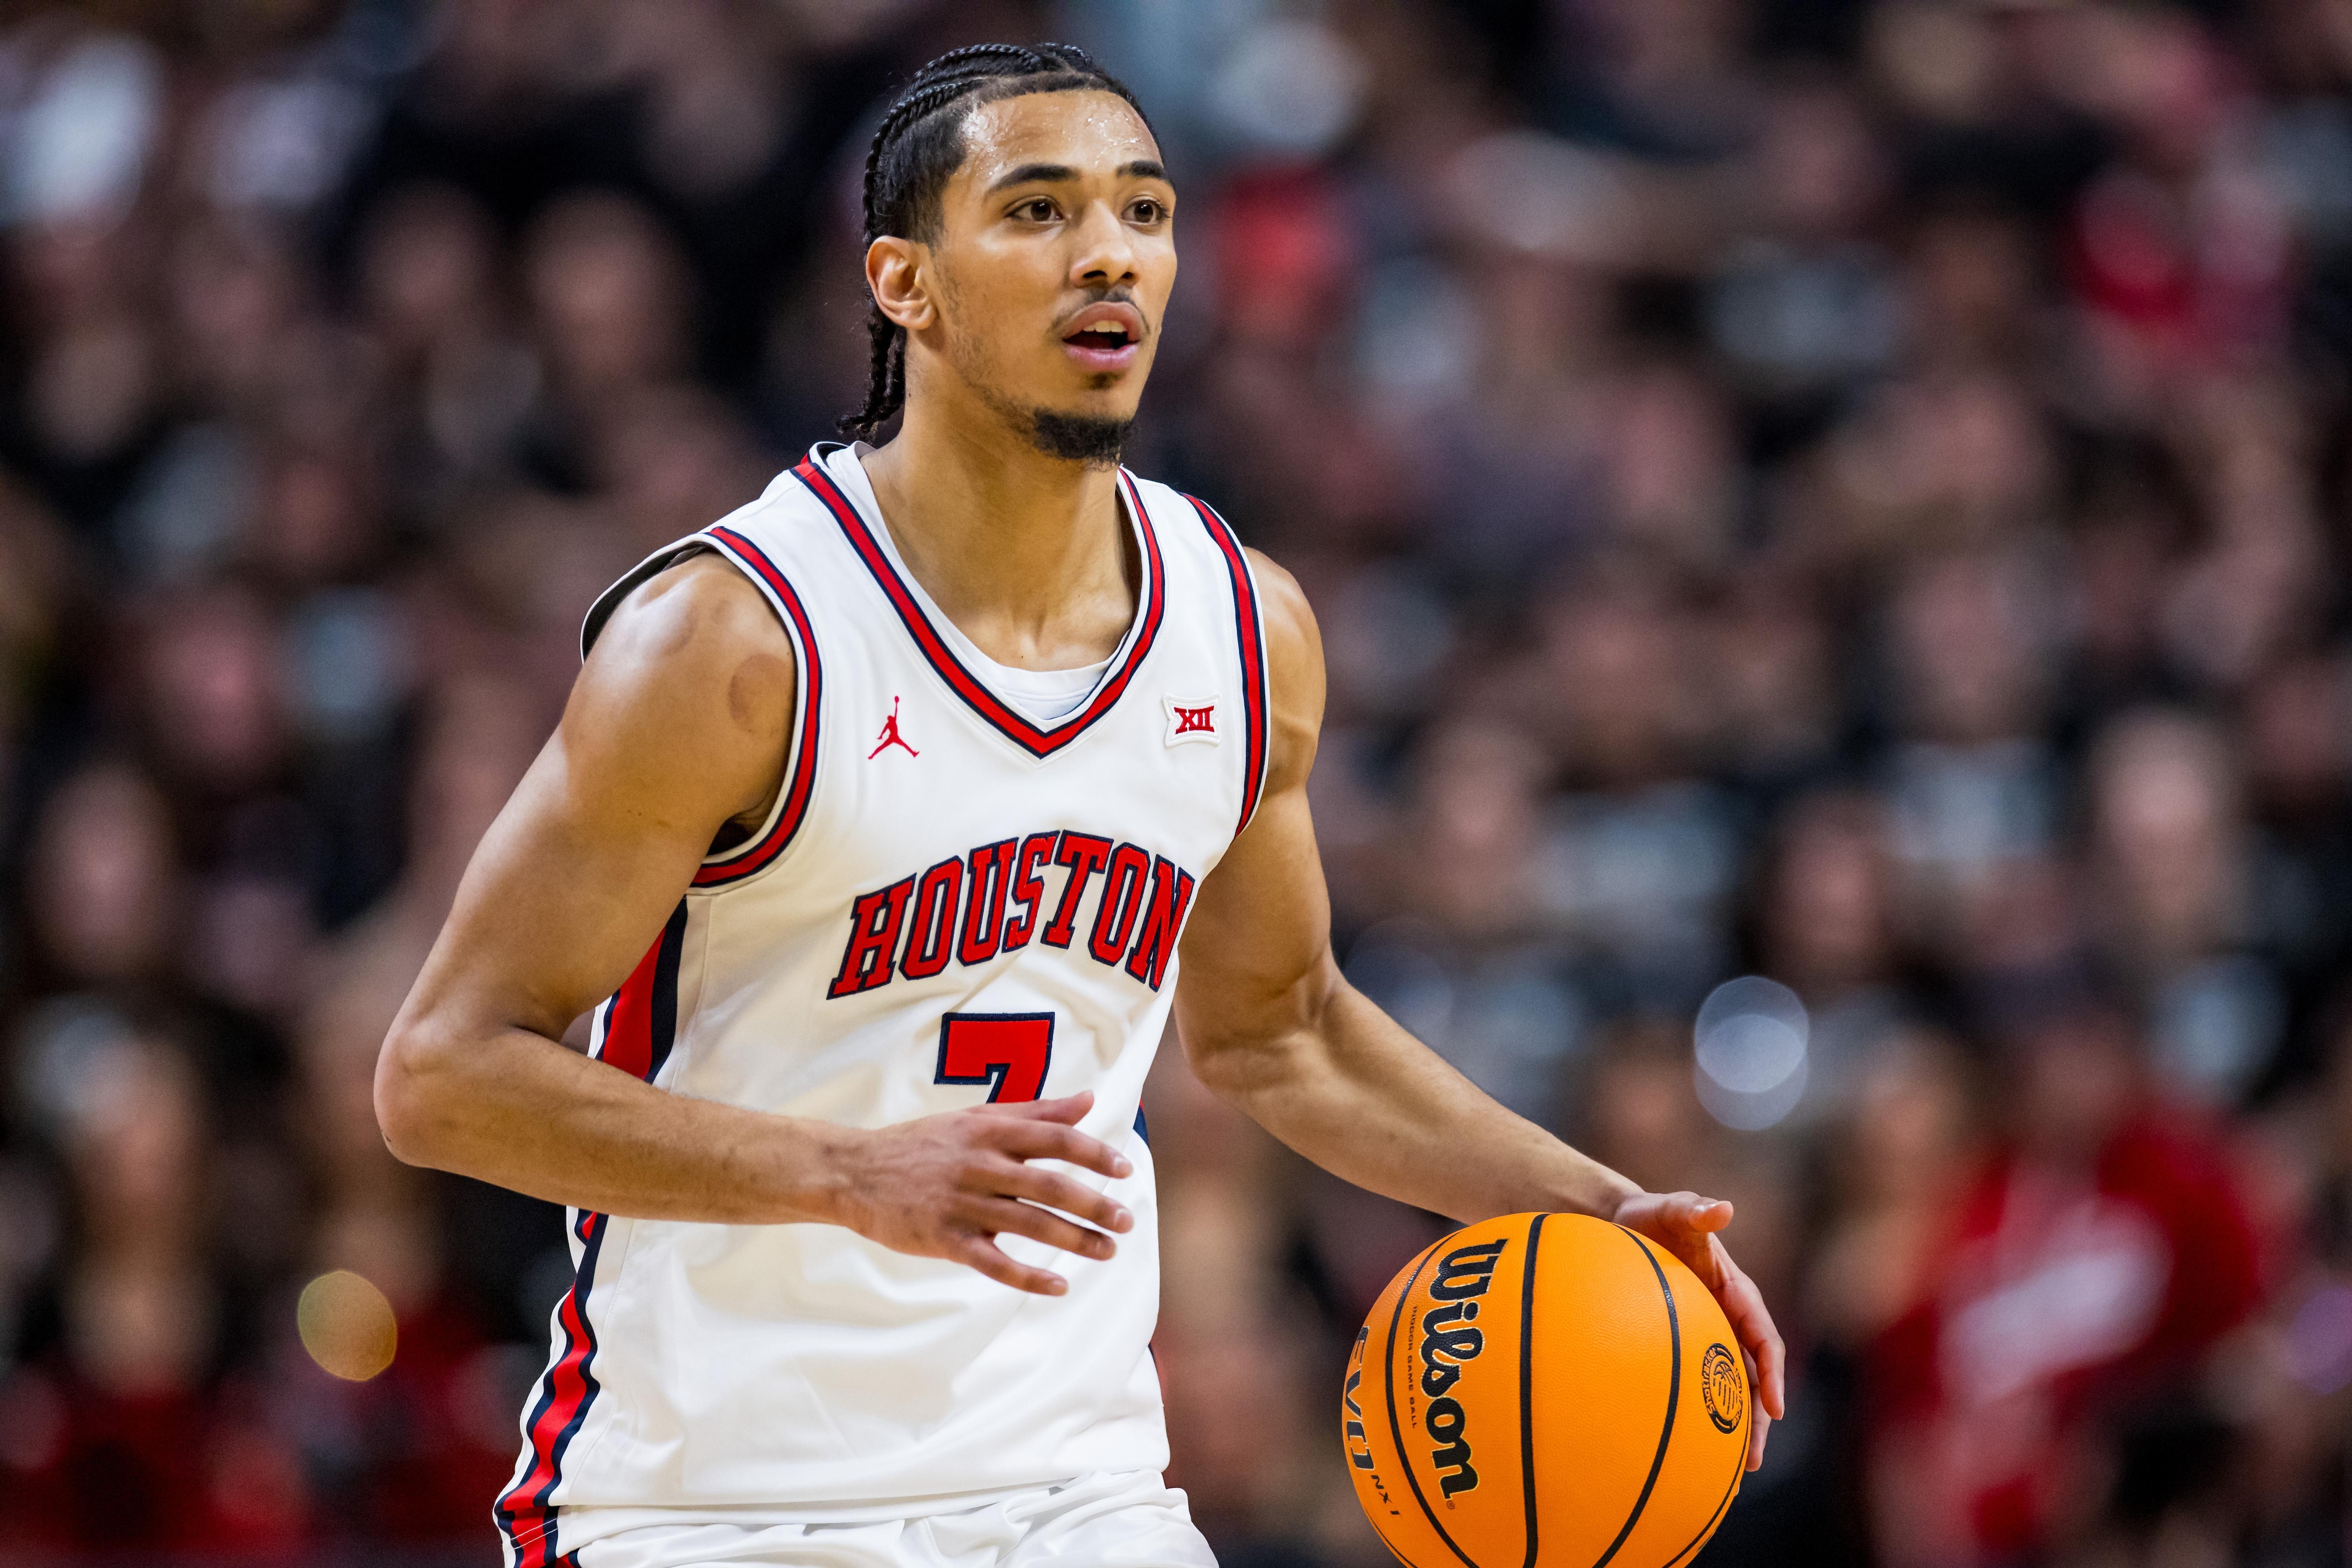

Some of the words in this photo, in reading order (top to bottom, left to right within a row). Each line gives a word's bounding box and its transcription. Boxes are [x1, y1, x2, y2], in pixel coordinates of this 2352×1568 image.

[1174, 705, 1215, 735] XII
[826, 829, 1195, 1000] HOUSTON
[934, 1011, 1055, 1104] 7
[1407, 1306, 1418, 1351] INDOOR
[1419, 1238, 1510, 1500] Wilson
[1345, 1326, 1375, 1470] EVO
[1409, 1396, 1417, 1429] BALL
